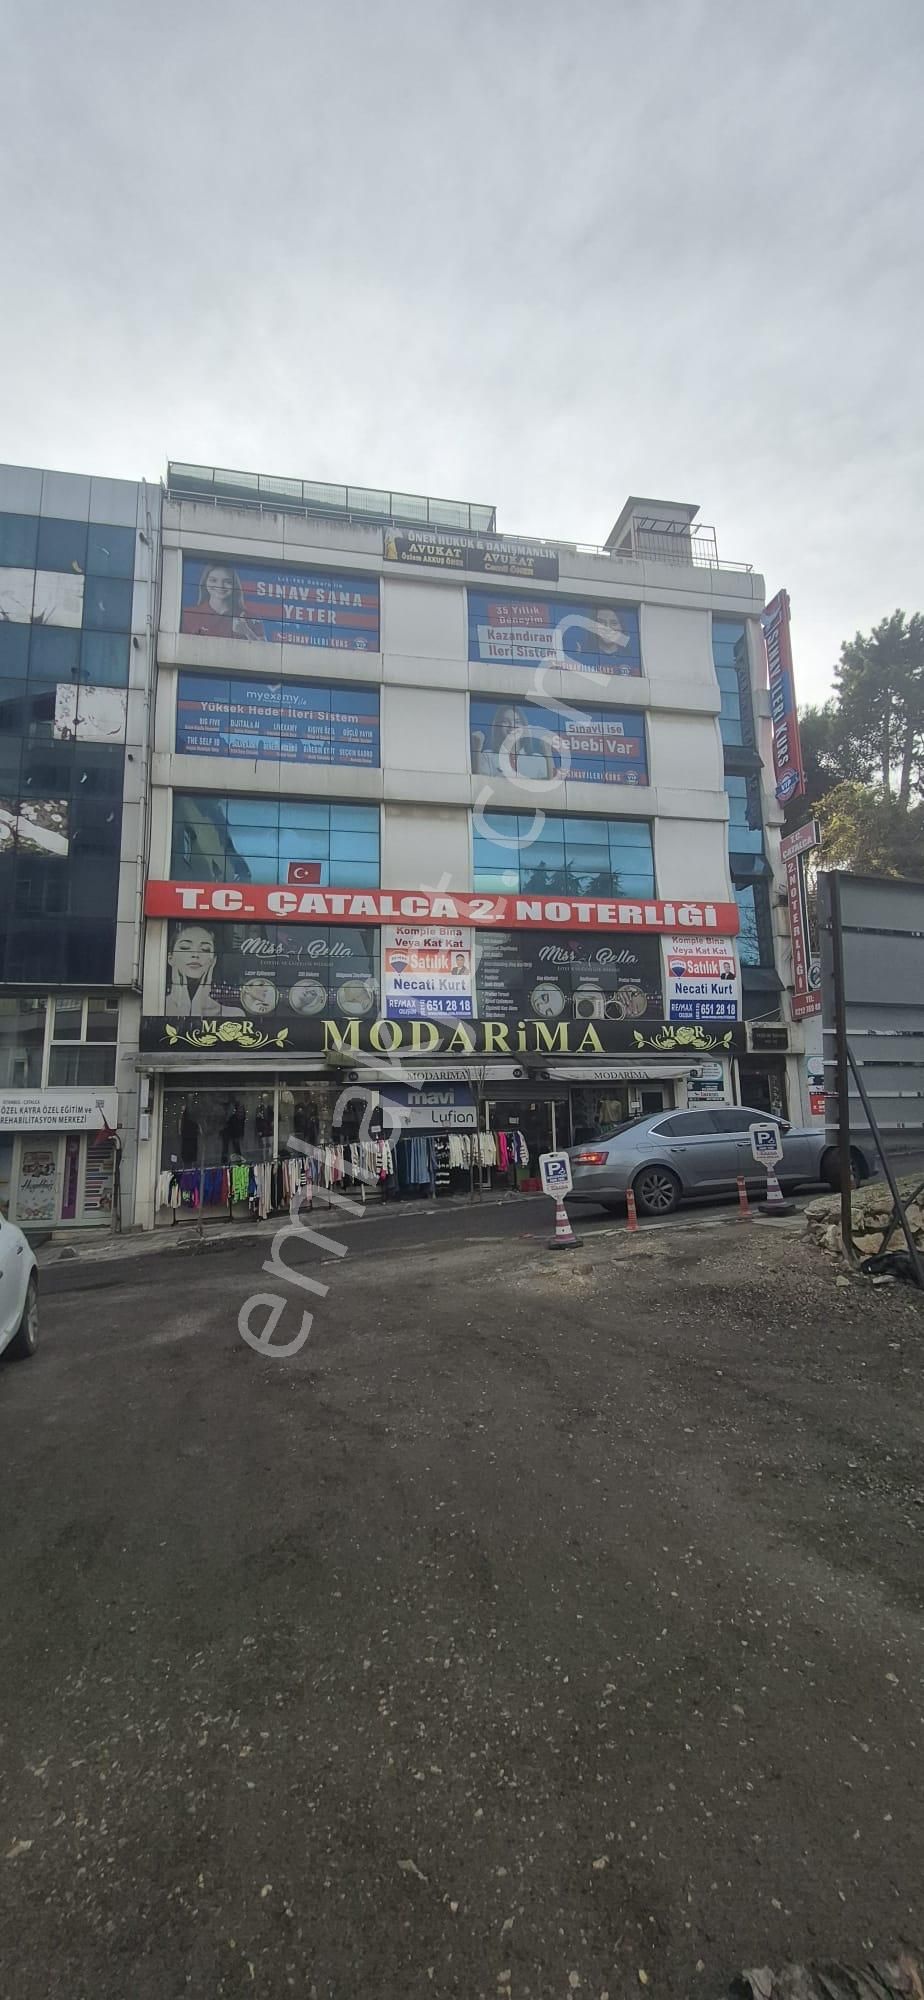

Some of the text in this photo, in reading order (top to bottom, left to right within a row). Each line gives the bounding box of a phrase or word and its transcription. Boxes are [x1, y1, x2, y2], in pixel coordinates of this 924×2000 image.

[408, 544, 462, 558] AVUKAT
[438, 535, 475, 549] HUKUK
[485, 542, 557, 559] DANIŞMANLIK
[483, 553, 535, 567] AVUKAT
[256, 581, 309, 601] SINAV
[316, 590, 363, 608] SANA
[283, 604, 337, 624] YETER
[496, 606, 541, 616] 35 Yıllık
[499, 616, 544, 626] Deneyim
[487, 629, 553, 643] Kazandıran
[516, 646, 557, 658] Sistem
[246, 690, 298, 705] myexamy
[200, 702, 245, 715] Yüksek
[317, 711, 359, 724] Sistem
[552, 736, 633, 755] Sebebi Var
[774, 725, 790, 769] KURS
[176, 887, 717, 927] T.C. ÇATALCA 2. NOTERLİĞİ
[396, 927, 462, 937] Komple Bina
[395, 938, 464, 948] Veya Kat Kat
[671, 936, 704, 946] Komple
[672, 946, 694, 955] Veya
[695, 947, 711, 955] Kat
[410, 954, 449, 969] Satılık
[687, 960, 719, 974] Satılık
[393, 978, 466, 991] Necati Kurt
[675, 982, 733, 994] Necati Kurt
[389, 999, 416, 1008] RE/MAX
[427, 999, 443, 1011] 651
[446, 999, 457, 1011] 28
[460, 999, 471, 1011] 18
[671, 1003, 693, 1012] RE/MAX
[700, 1004, 714, 1015] 651
[715, 1004, 725, 1015] 28
[726, 1004, 736, 1015] 18
[407, 1088, 455, 1105] mavi
[1, 1105, 17, 1115] ÖZEL
[20, 1106, 41, 1115] KAYRA
[42, 1104, 60, 1114] ÖZEL
[61, 1104, 83, 1114] EĞİTİM
[0, 1114, 87, 1124] REHABİLİTASYON MERKEZİ
[431, 1110, 474, 1124] Lufian
[757, 1132, 770, 1146] P
[547, 1161, 560, 1176] P
